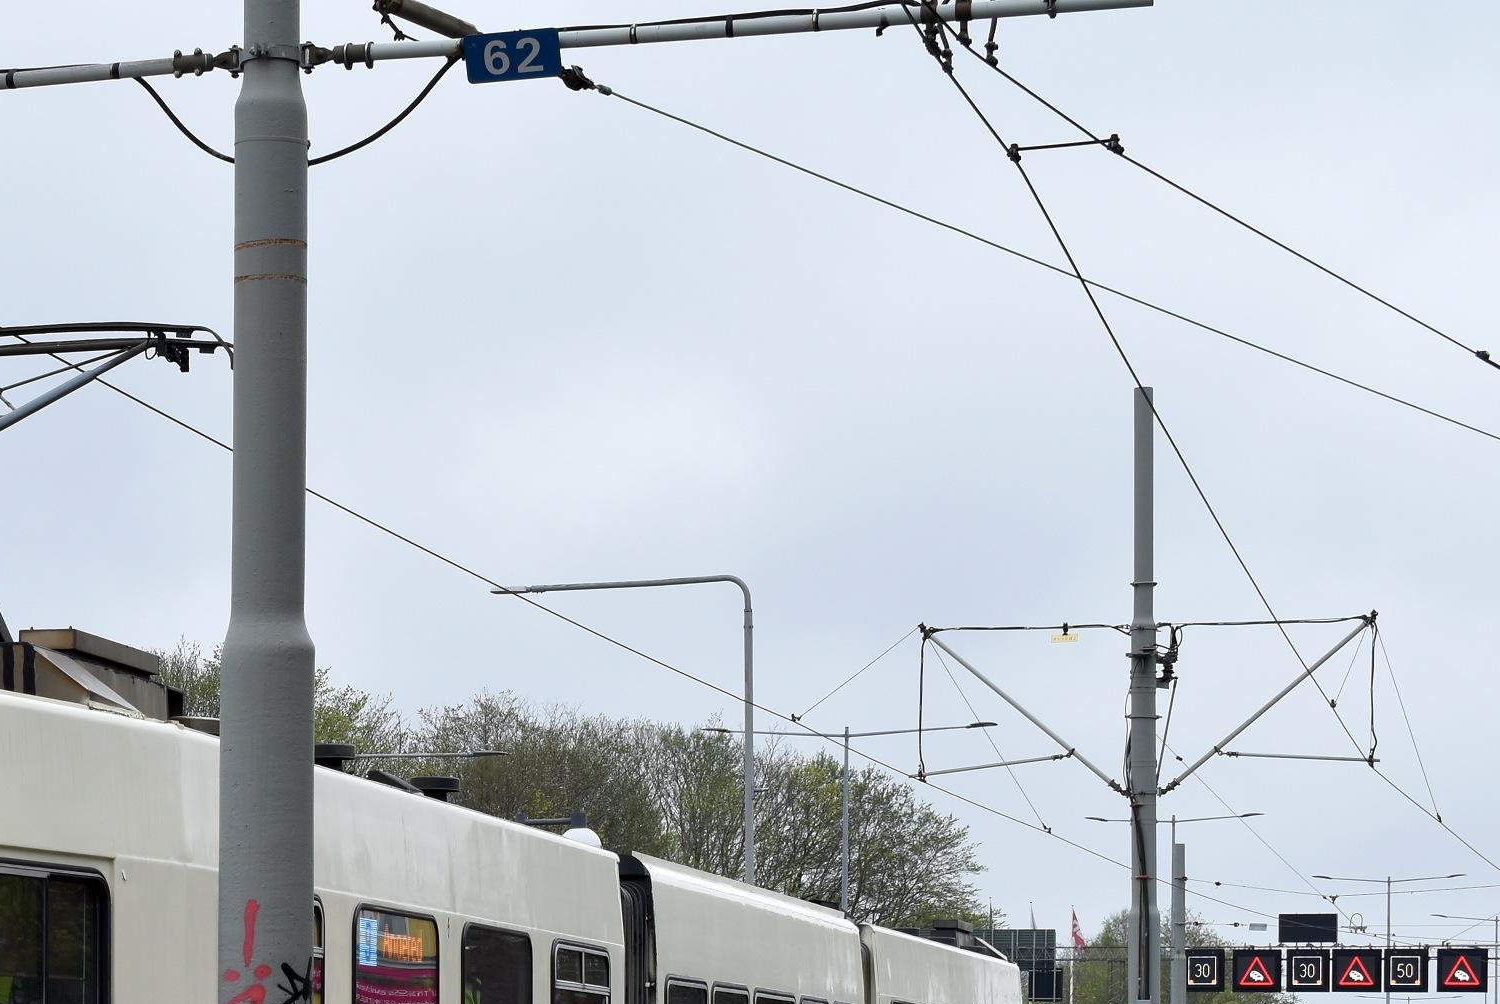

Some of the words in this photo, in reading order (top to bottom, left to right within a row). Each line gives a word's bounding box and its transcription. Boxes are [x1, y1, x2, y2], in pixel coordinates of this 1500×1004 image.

[483, 37, 544, 75] 62
[1194, 963, 1210, 978] 30
[1299, 963, 1316, 978] 30
[1396, 963, 1414, 978] 50
